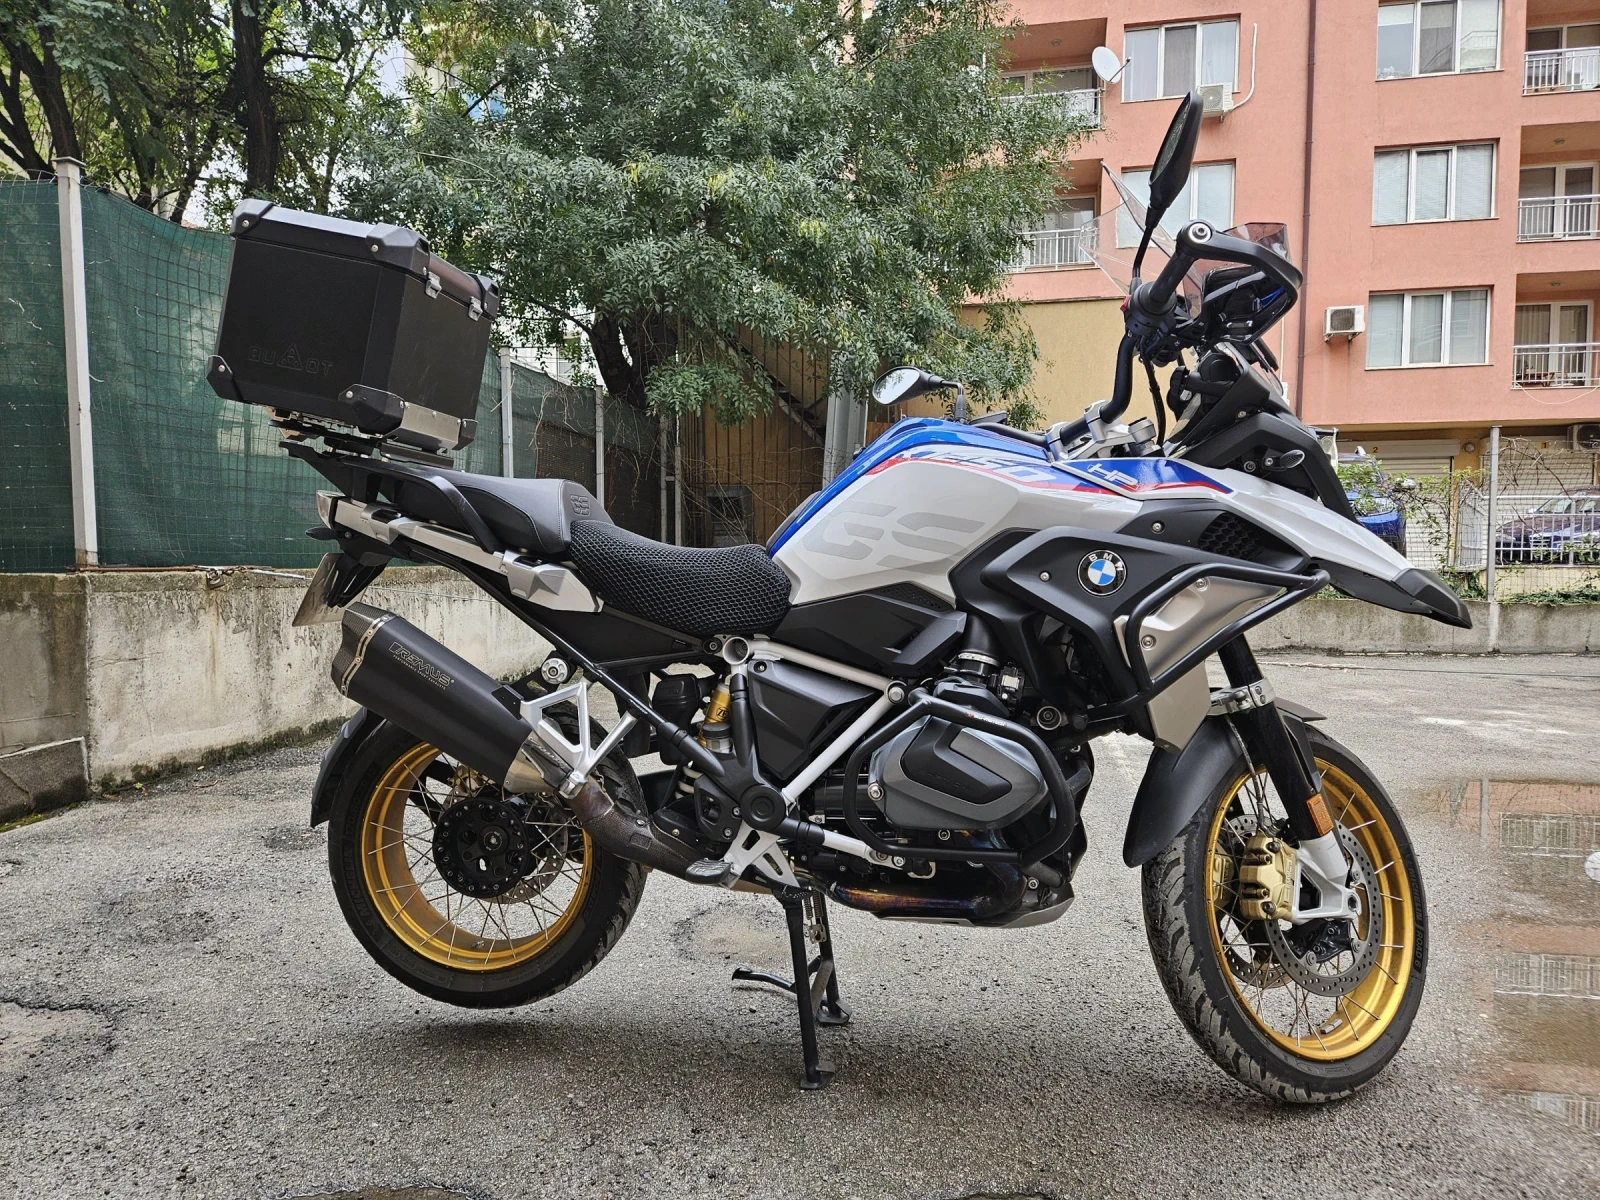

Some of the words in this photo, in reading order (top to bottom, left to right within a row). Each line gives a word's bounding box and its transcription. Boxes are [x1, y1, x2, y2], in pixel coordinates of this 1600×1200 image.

[1087, 463, 1138, 486] HP
[802, 501, 986, 576] GS
[1088, 553, 1124, 571] BMW
[389, 642, 451, 687] REMUS
[344, 845, 369, 917] MICHELIN
[1408, 868, 1423, 921] MICHELIN
[1416, 930, 1424, 959] ROAD
